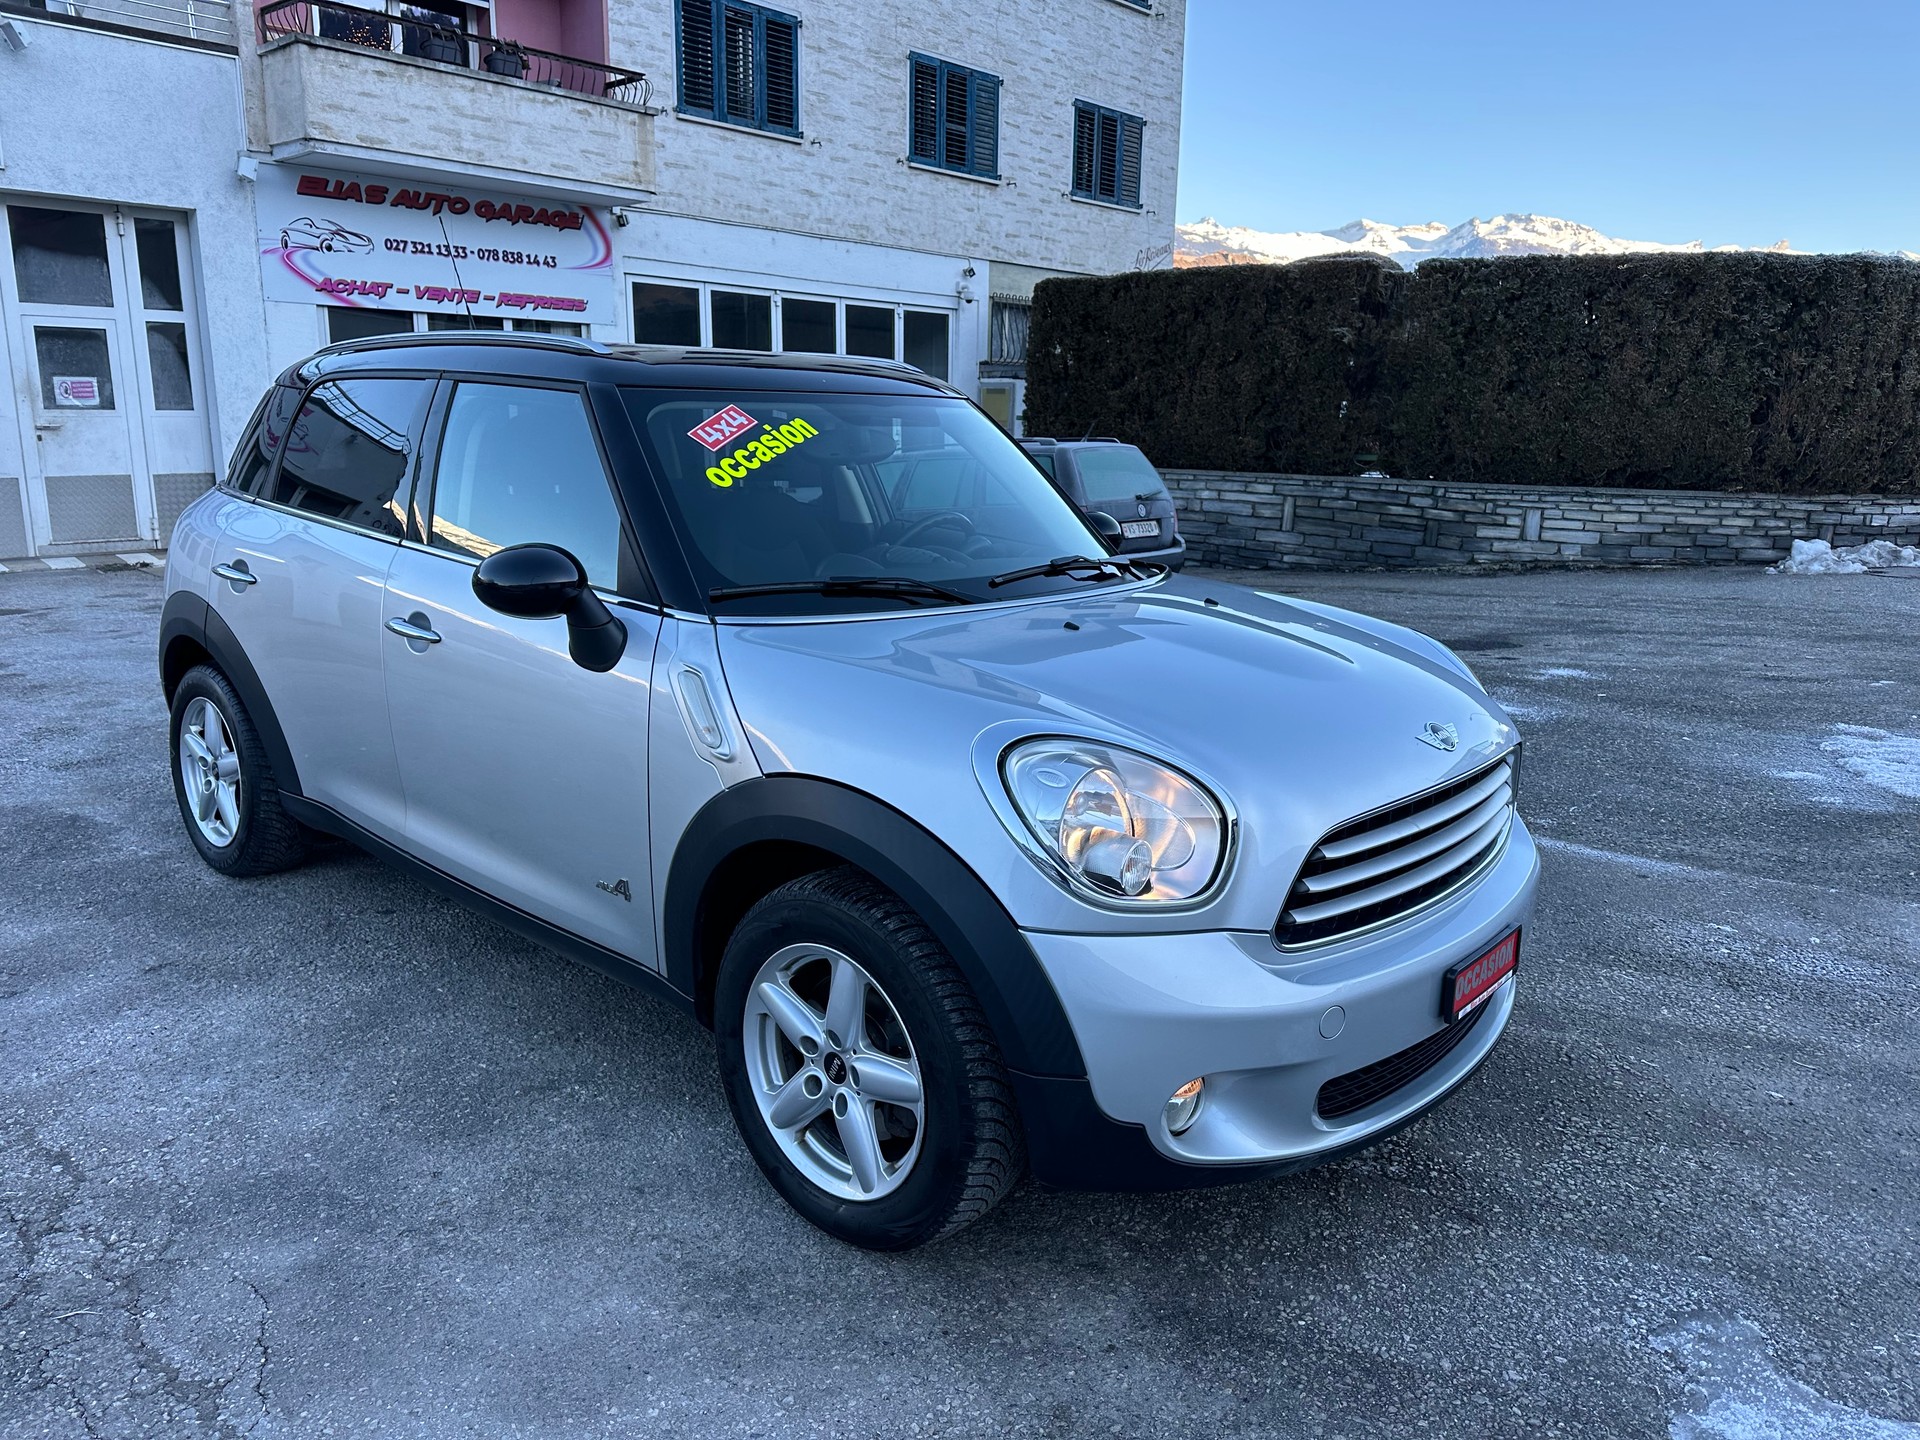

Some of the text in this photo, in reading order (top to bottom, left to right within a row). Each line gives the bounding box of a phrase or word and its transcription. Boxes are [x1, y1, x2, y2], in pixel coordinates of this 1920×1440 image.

[296, 175, 585, 232] ELIAS AUTO GARAGE
[384, 238, 408, 253] 027
[410, 241, 434, 255] 321
[436, 244, 450, 257] 13
[452, 245, 468, 259] 33
[477, 248, 499, 261] 078
[502, 250, 524, 264] 838
[526, 254, 540, 267] 14
[542, 256, 557, 268] 43
[316, 277, 393, 300] ACHAT
[414, 285, 480, 305] VENTE
[496, 292, 588, 312] REPRISES
[696, 410, 749, 443] 4x4
[705, 417, 819, 488] occasion
[1455, 936, 1515, 1001] OCCASION
